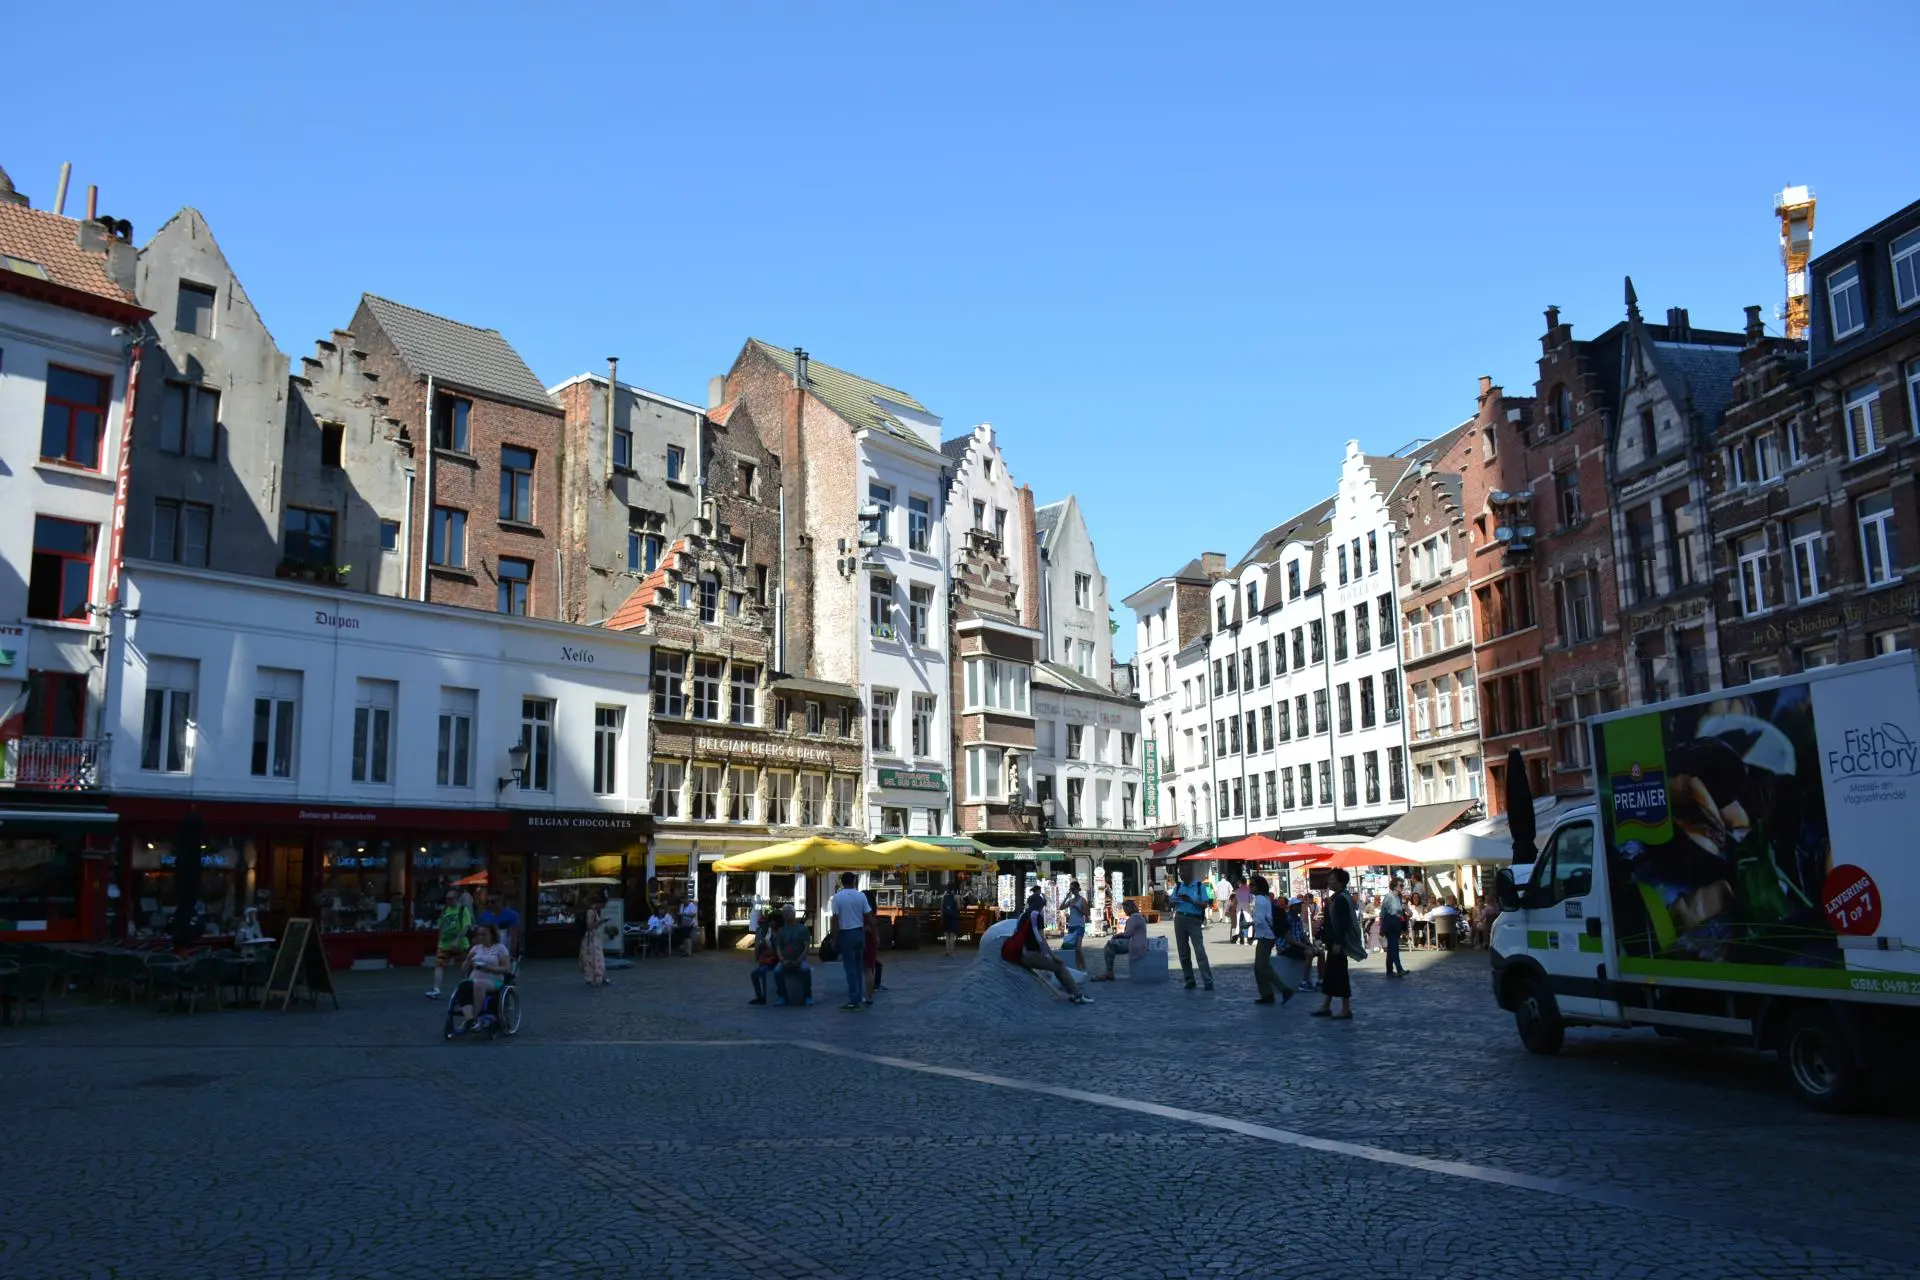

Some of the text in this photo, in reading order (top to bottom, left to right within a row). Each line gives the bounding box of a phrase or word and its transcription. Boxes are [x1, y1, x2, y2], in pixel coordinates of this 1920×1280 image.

[109, 360, 140, 590] PIZZERIA
[315, 610, 359, 629] Dupon
[561, 646, 594, 663] Nello
[699, 737, 831, 760] BELGIAN BEERS & BREWS
[1845, 727, 1886, 754] Fish
[1829, 746, 1917, 775] Factory
[1614, 788, 1666, 810] PREMIER
[528, 817, 631, 828] BELGIAN CHOCOLATES
[1824, 876, 1870, 914] LEVERING
[1836, 893, 1872, 928] 7 OP 7
[1883, 980, 1909, 993] 0498
